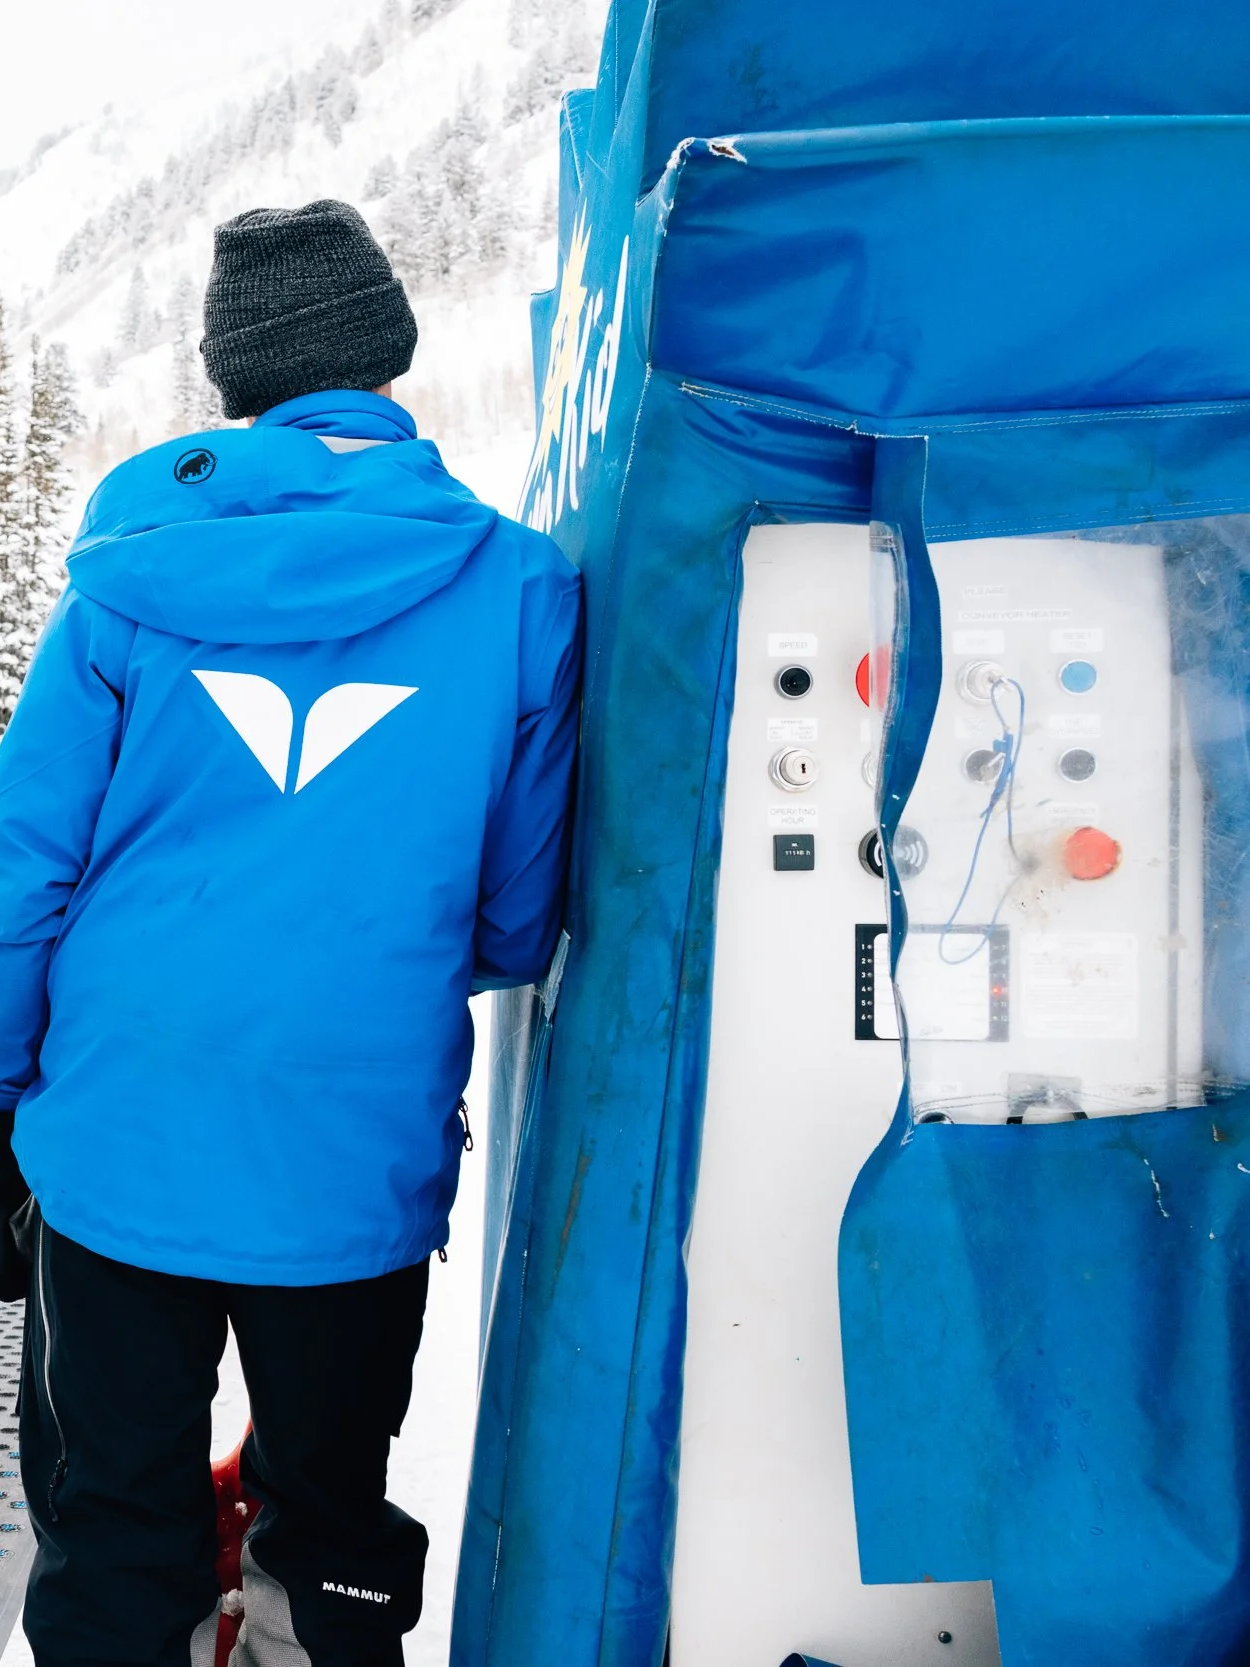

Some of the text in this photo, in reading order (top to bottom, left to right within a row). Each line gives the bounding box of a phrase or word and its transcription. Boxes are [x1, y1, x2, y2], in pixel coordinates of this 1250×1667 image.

[961, 609, 1072, 619] CONVEYOR HEATER
[779, 641, 808, 649] SPEED
[769, 808, 816, 816] OPERATING
[781, 817, 804, 825] HOUR
[322, 1582, 391, 1604] MAMMUT
